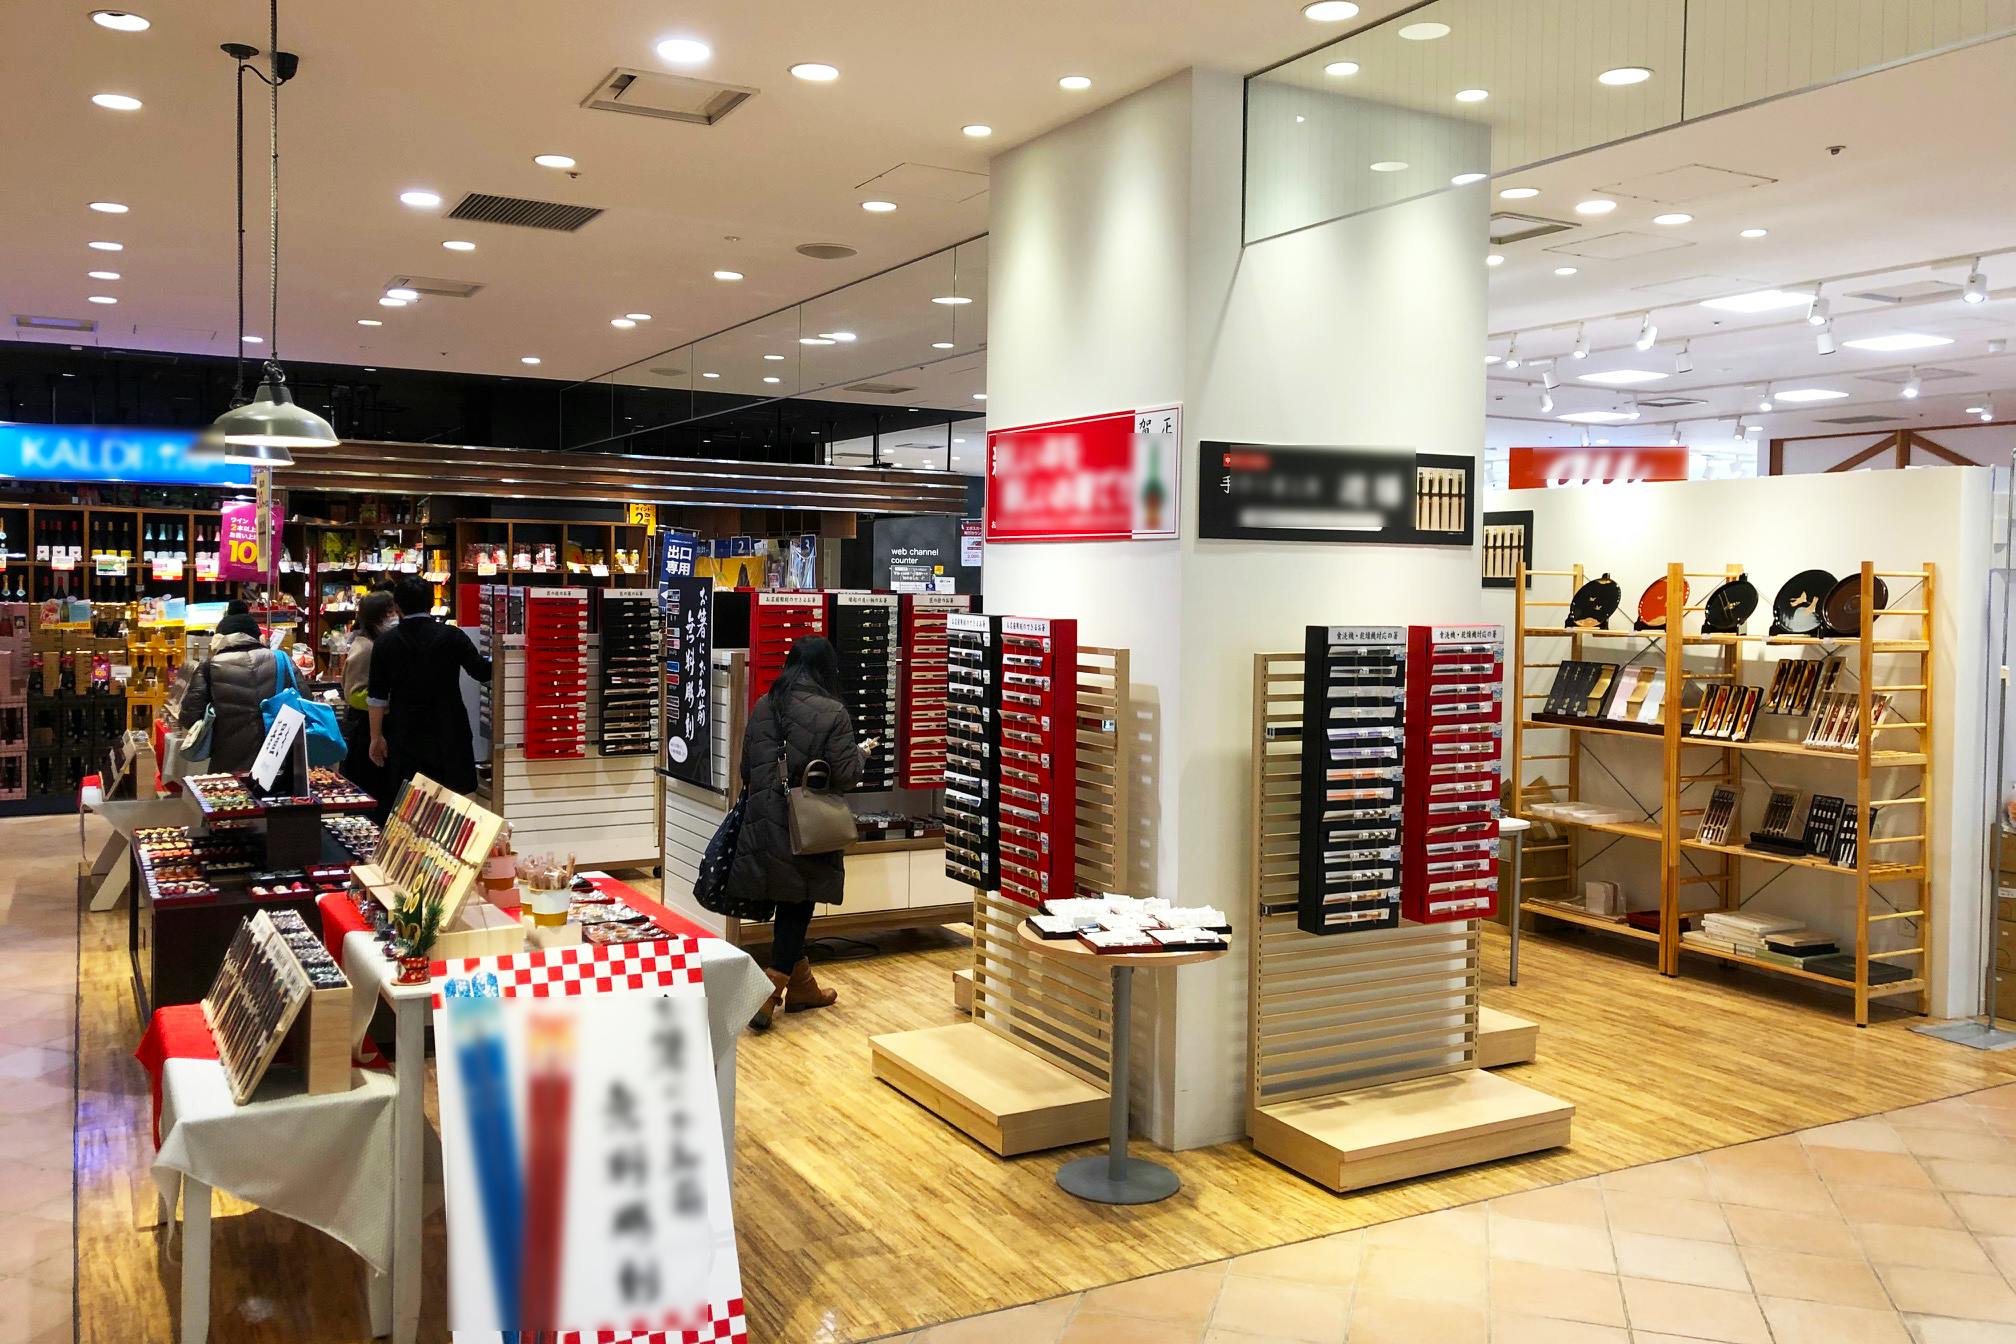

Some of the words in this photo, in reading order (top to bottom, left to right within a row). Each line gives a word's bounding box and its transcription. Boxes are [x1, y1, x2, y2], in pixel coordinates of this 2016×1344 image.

[667, 545, 692, 561] 出口
[738, 540, 745, 554] 2
[891, 548, 907, 556] web
[909, 548, 939, 556] channel
[665, 560, 691, 576] 専用
[696, 587, 708, 727] お箸にお名前
[684, 609, 695, 741] 無料彫刻
